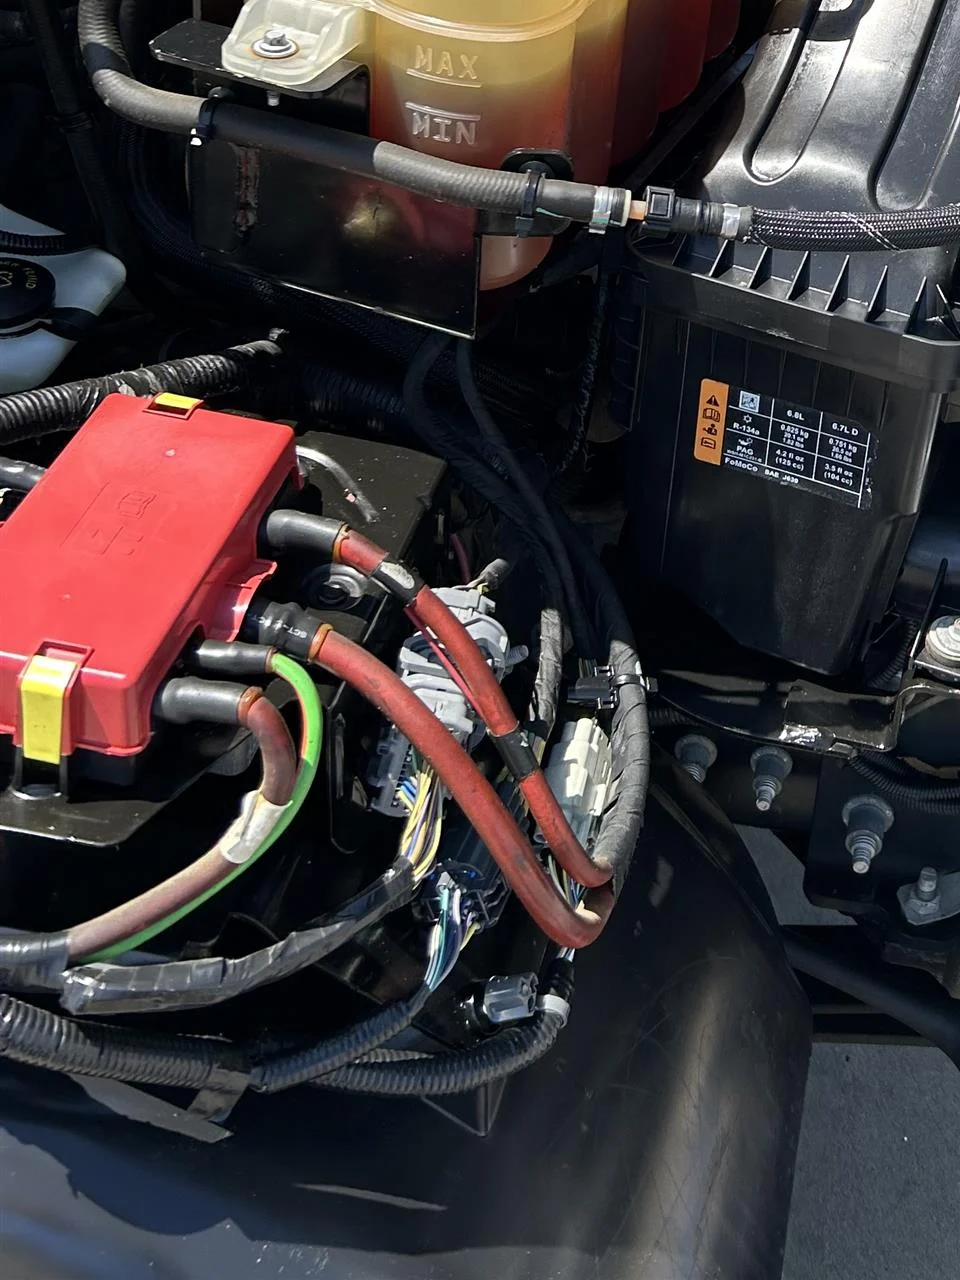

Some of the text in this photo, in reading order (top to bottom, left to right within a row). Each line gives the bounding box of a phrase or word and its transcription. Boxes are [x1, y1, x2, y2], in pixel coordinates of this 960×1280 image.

[414, 44, 478, 80] MAX
[412, 112, 476, 145] MIN
[786, 409, 805, 421] 6.8L
[733, 422, 760, 435] R-134a
[780, 424, 809, 439] 0.825 kg
[832, 422, 859, 436] 6.7L D
[736, 445, 754, 455] PAG
[828, 438, 857, 453] 0.751 kg
[775, 449, 787, 457] 4.2
[725, 457, 758, 472] FoMoCo
[782, 475, 799, 484] J639
[775, 457, 804, 471] (125 cc)
[824, 463, 836, 472] 3.5
[824, 471, 853, 486] (104 cc)
